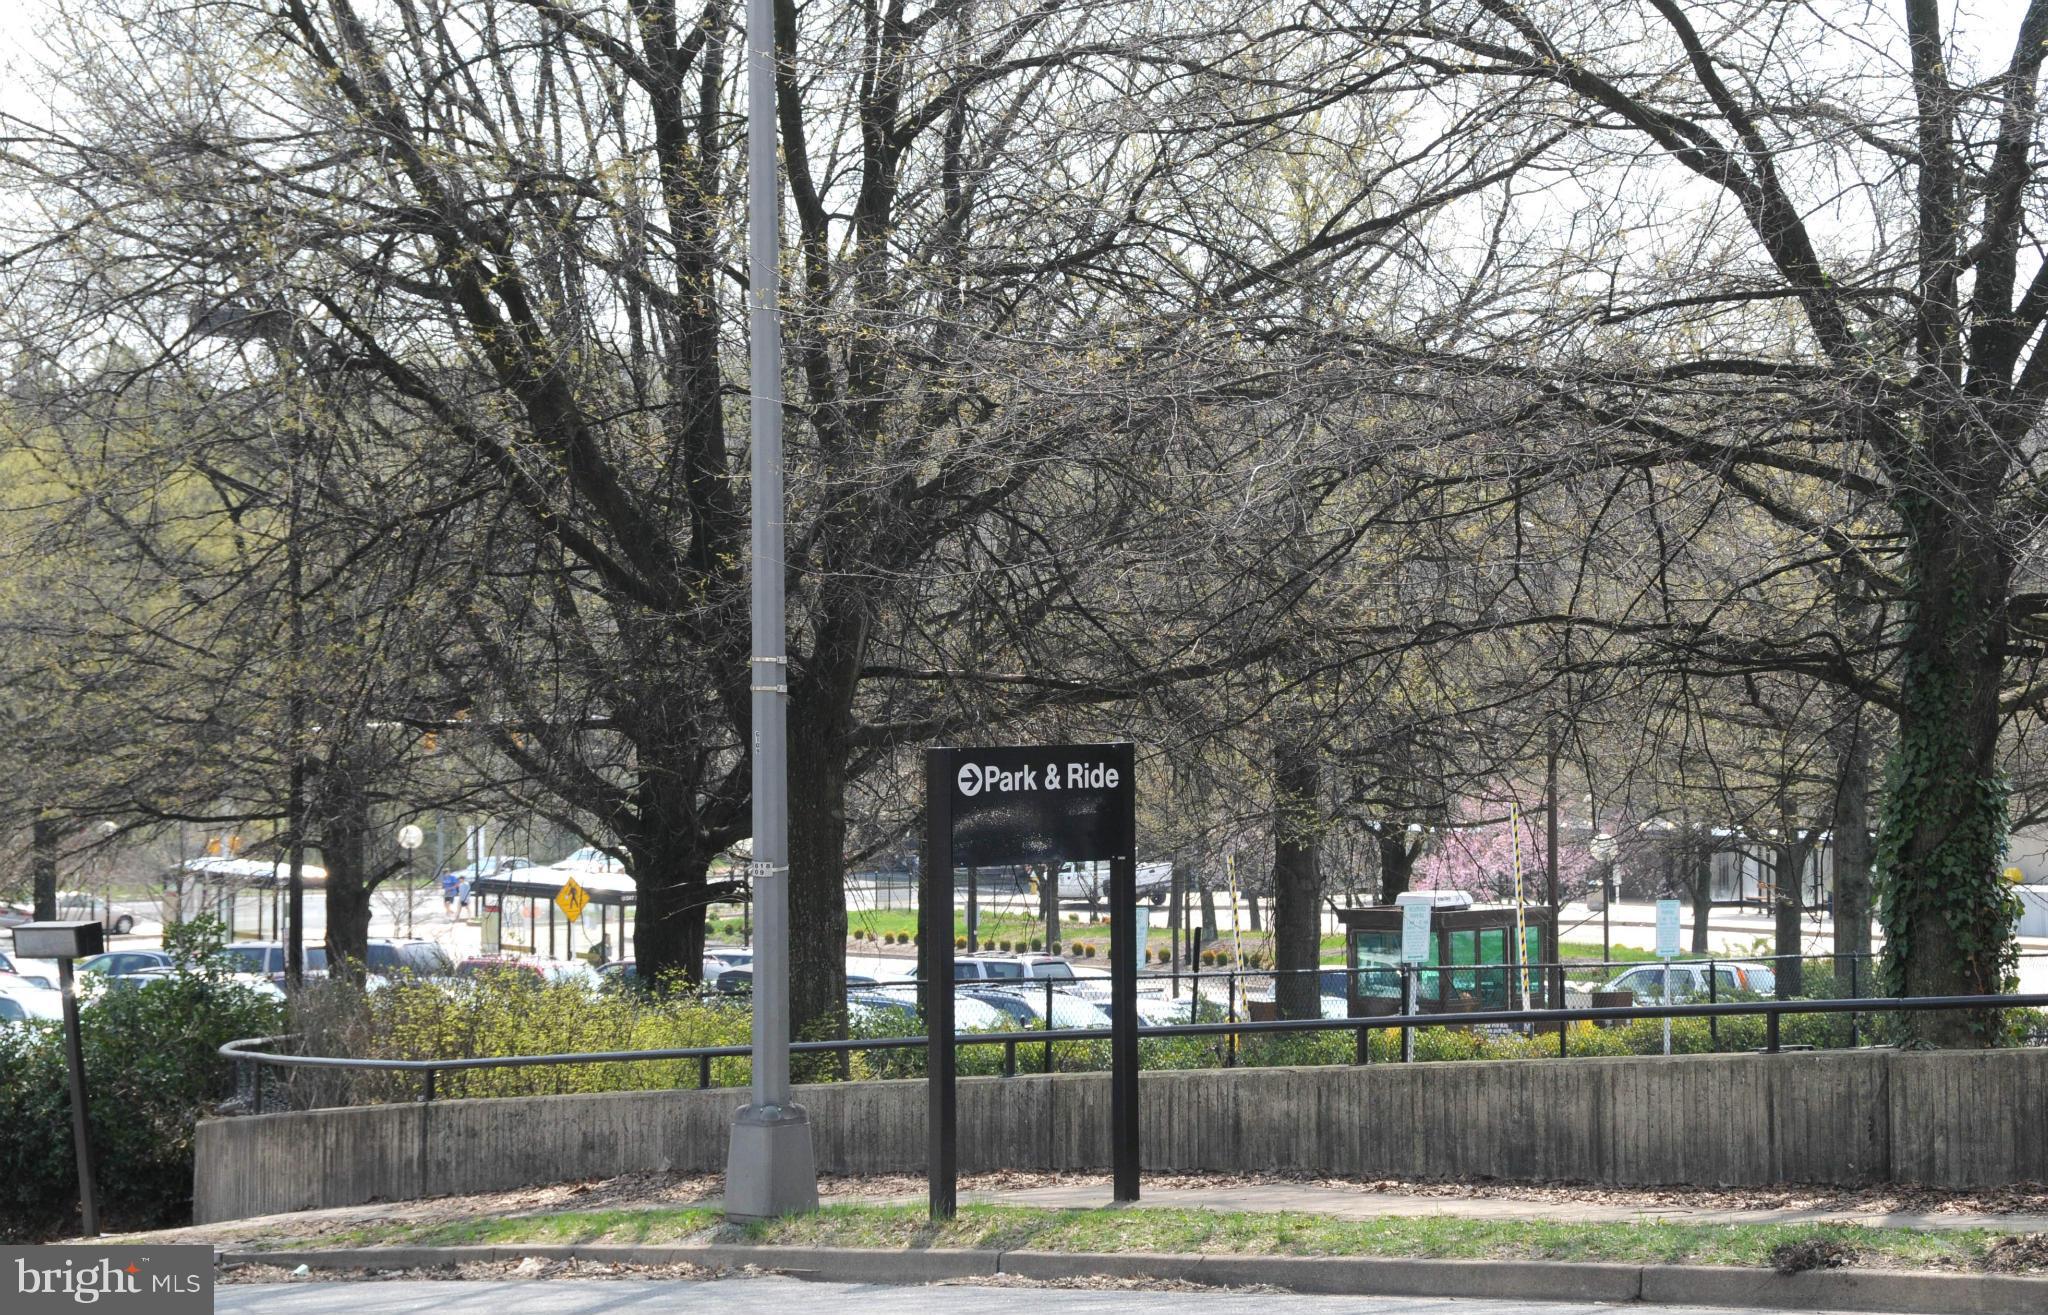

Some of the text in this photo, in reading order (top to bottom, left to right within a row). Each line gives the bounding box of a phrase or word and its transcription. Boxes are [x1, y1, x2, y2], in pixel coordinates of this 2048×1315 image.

[984, 762, 1119, 792] Park & Ride
